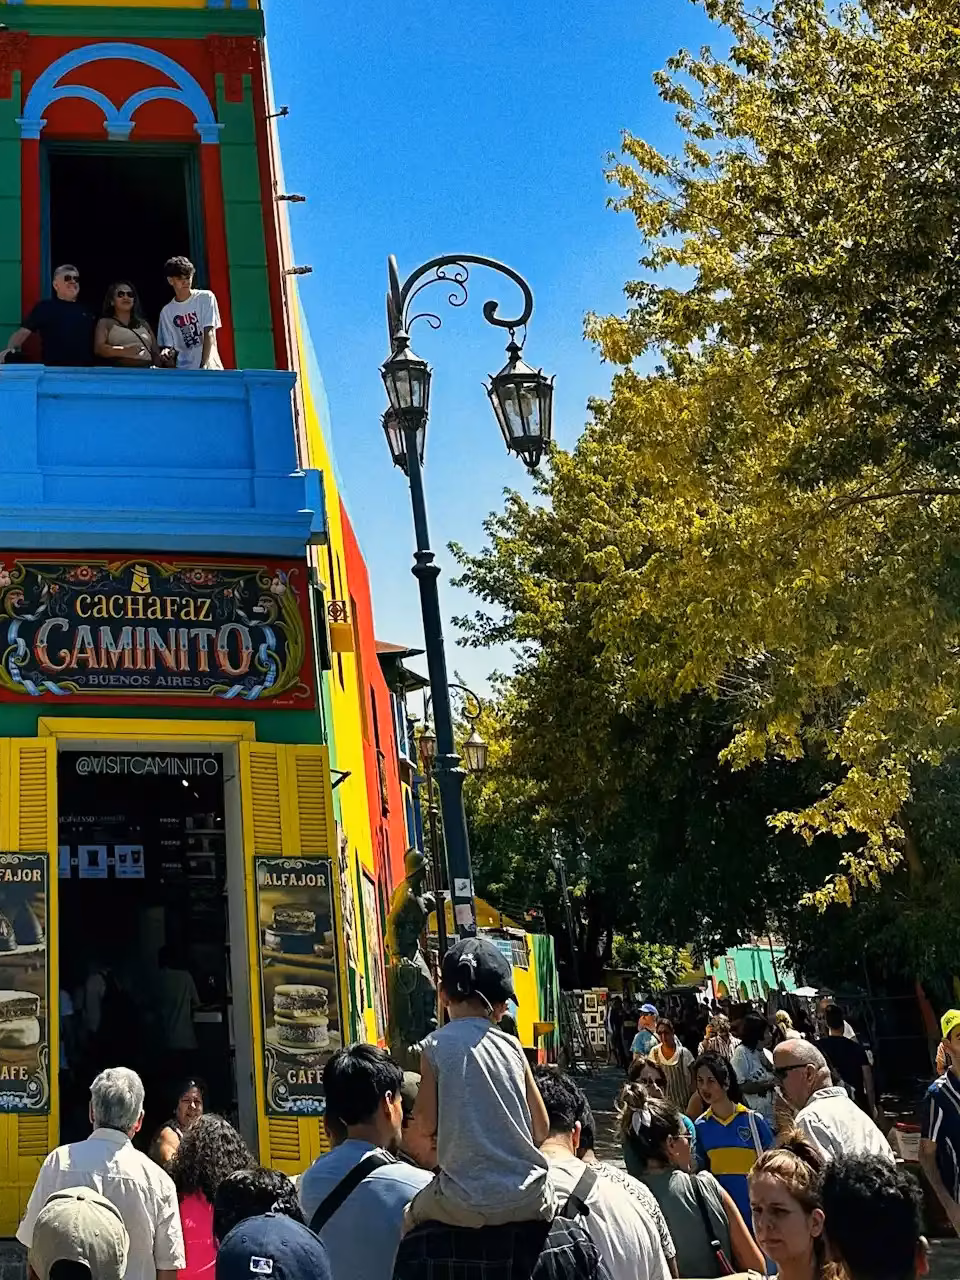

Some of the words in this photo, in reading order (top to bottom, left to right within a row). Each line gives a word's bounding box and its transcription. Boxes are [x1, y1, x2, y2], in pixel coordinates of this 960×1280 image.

[34, 618, 255, 676] CAMINITO
[89, 674, 151, 686] BUENOS
[156, 675, 201, 687] AIRES
[75, 756, 219, 776] @VISITCAMINITO
[263, 872, 326, 888] ALFAJOR
